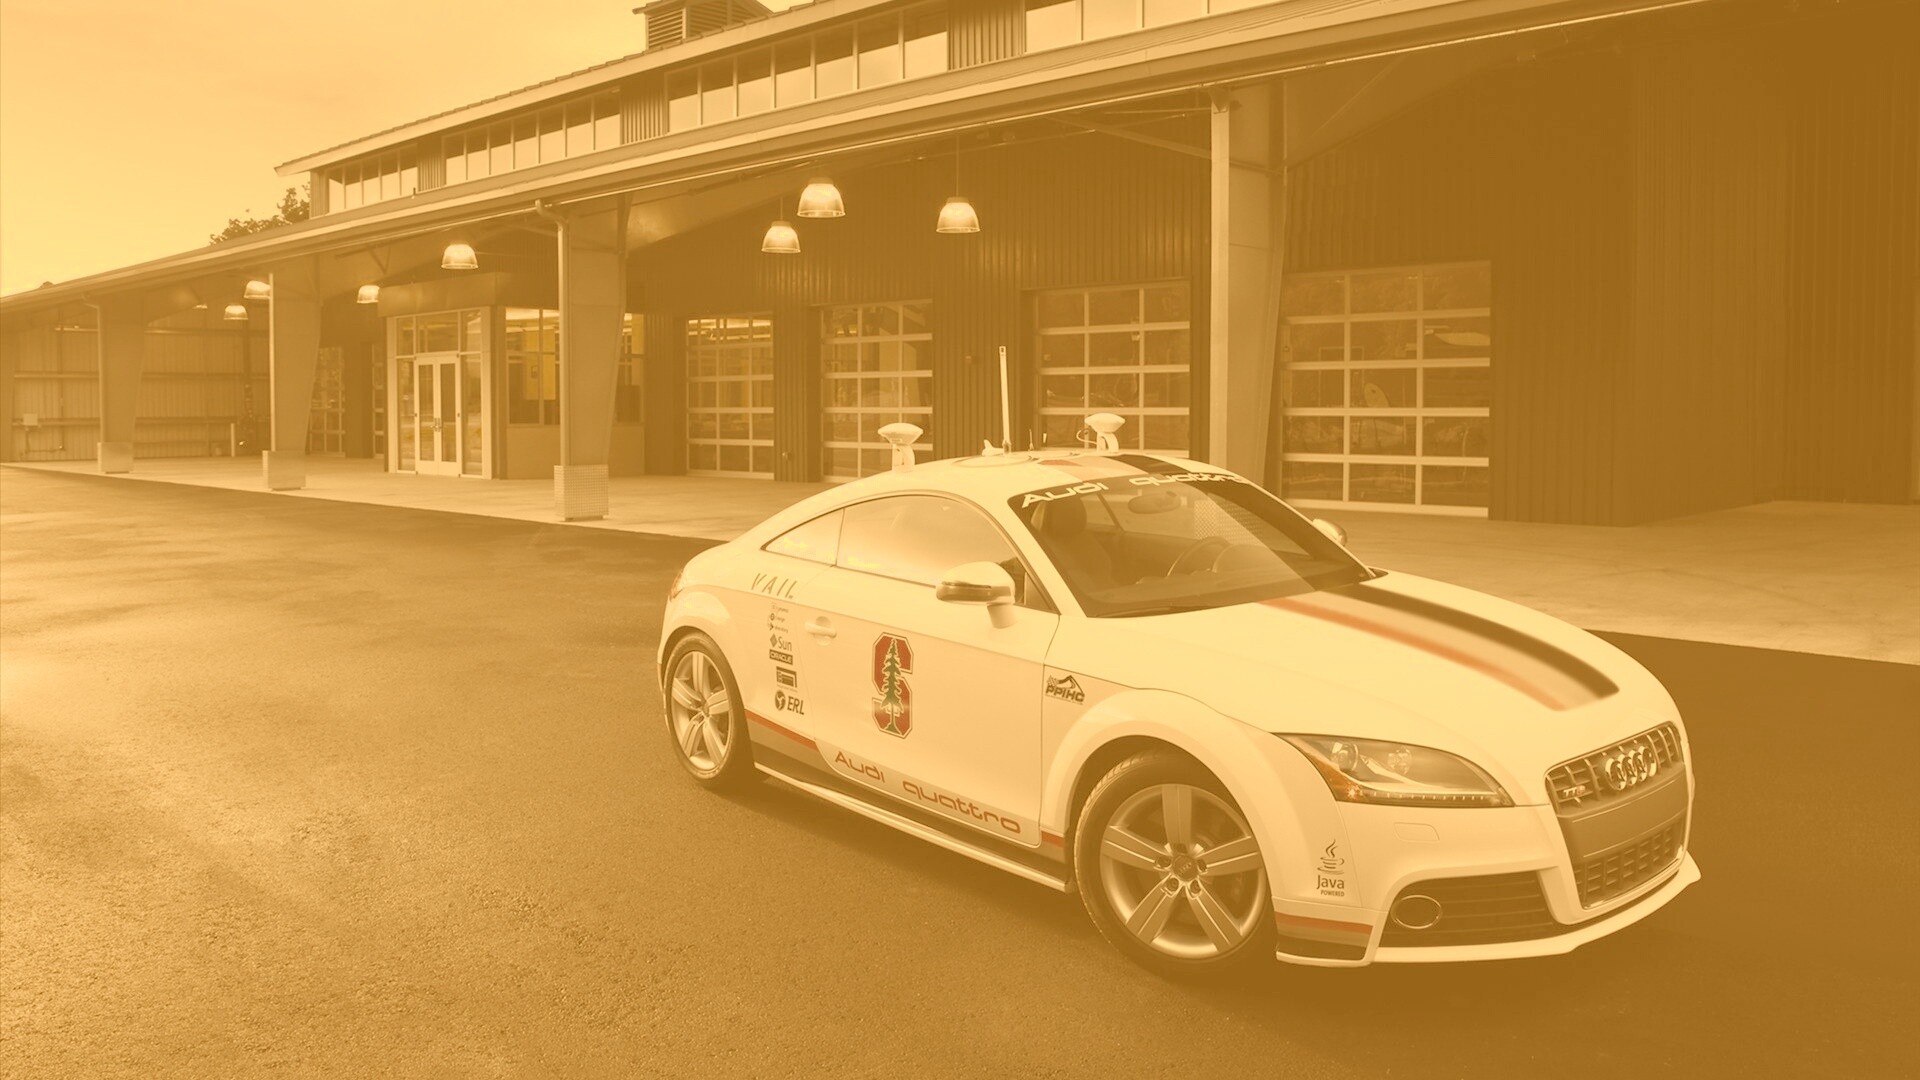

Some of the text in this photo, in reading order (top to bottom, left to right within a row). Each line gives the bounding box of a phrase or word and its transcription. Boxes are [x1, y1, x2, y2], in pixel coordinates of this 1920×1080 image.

[1022, 472, 1248, 508] Audi quattro
[751, 573, 798, 598] VAIL
[777, 636, 792, 651] Sun
[1046, 684, 1085, 702] PPIHC
[787, 696, 805, 715] ERL
[835, 750, 1021, 833] Audi quattro
[1316, 874, 1345, 889] Java
